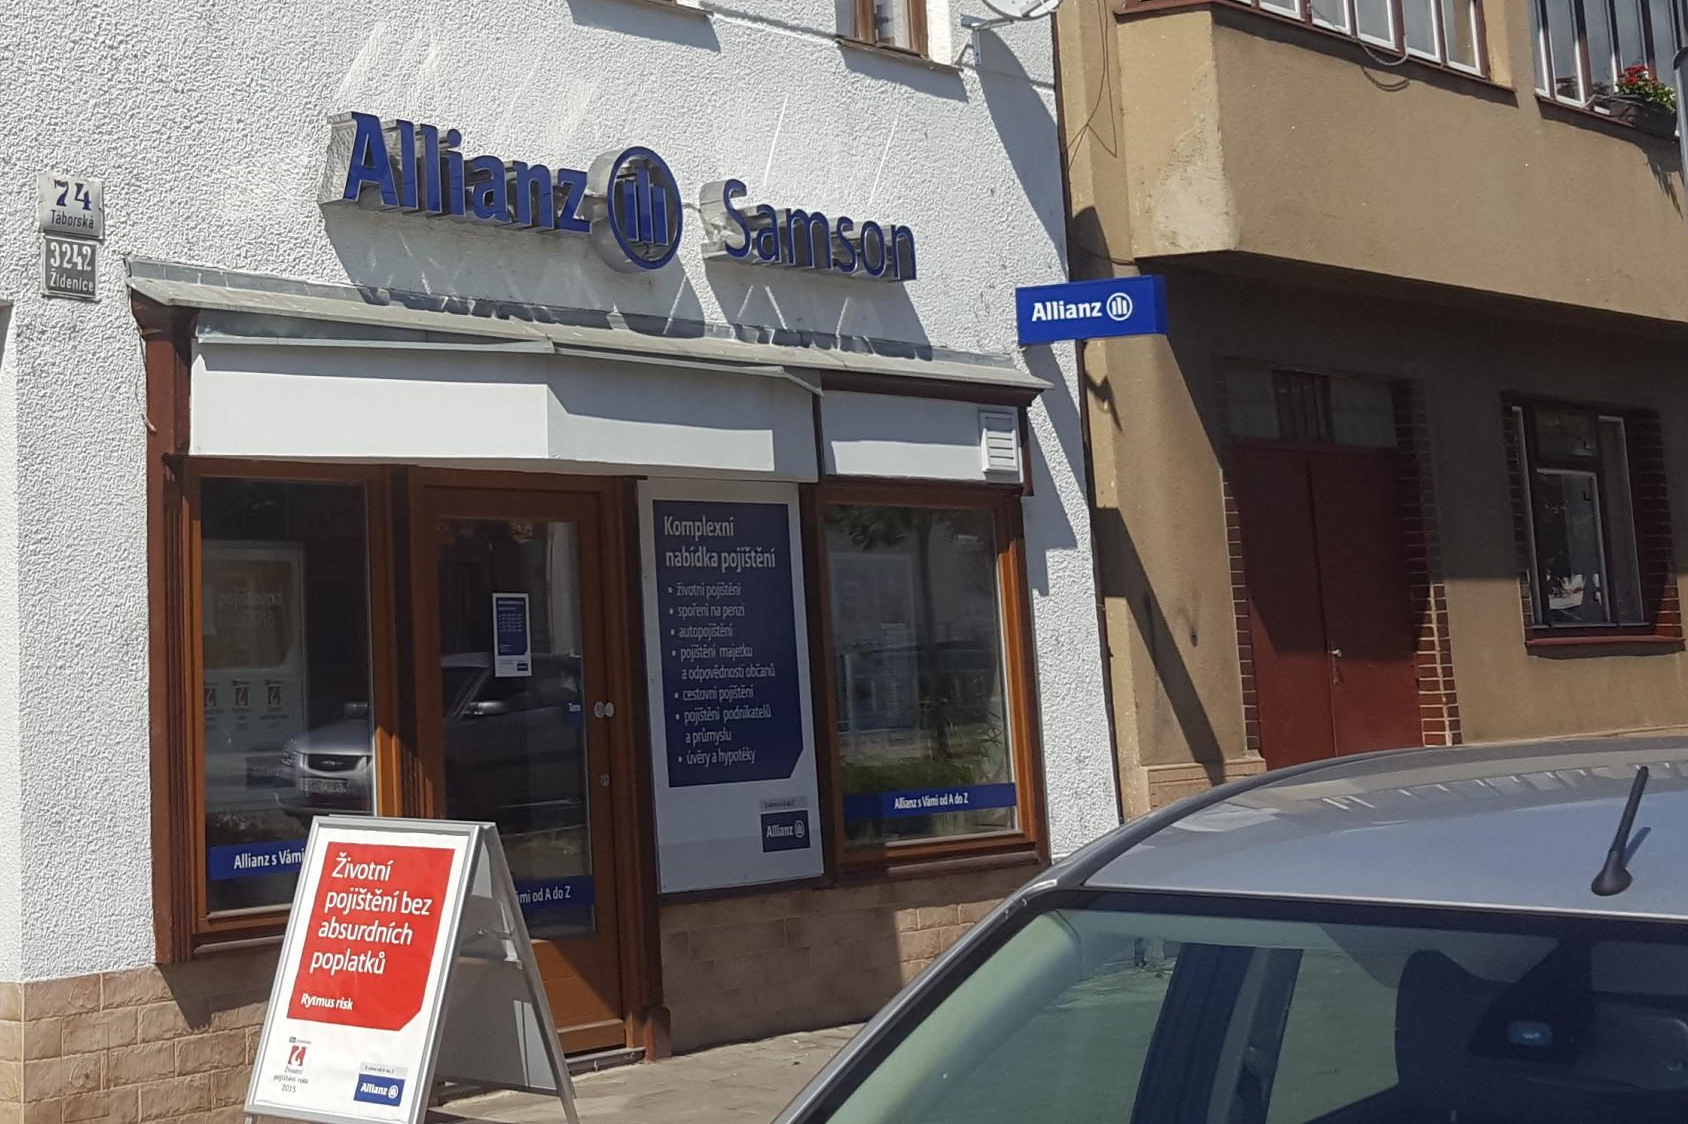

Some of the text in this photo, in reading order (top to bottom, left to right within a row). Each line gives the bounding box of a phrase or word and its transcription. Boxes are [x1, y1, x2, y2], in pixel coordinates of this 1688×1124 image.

[54, 179, 92, 211] 74
[342, 110, 918, 281] Allianz Samson
[50, 209, 94, 229] Táborská
[50, 242, 92, 271] 3242
[50, 268, 94, 292] Židenice
[1031, 301, 1102, 322] Allianz
[664, 516, 734, 541] Komplexní
[665, 546, 776, 573] nabídka pojištění
[676, 582, 741, 600] životní pojištění
[678, 603, 745, 620] spoření na penzi
[679, 623, 733, 641] autopojištění
[680, 644, 752, 662] pojištění majetku
[688, 664, 744, 683] odpovědnosti
[745, 662, 776, 677] občanů
[683, 684, 753, 703] cestovní pojištění
[684, 704, 772, 726] pojištění podnikatelů
[685, 727, 732, 746] a průmyslu
[686, 749, 711, 767] úvěry
[894, 797, 917, 810] Allianz
[922, 795, 938, 808] Vámi
[940, 795, 948, 806] od
[949, 795, 954, 805] A
[954, 793, 963, 805] do
[963, 793, 969, 804] Z
[767, 824, 794, 838] Allianz
[234, 851, 269, 870] Allianz
[271, 854, 277, 866] s
[331, 852, 393, 882] Životní
[324, 887, 432, 916] pojištění bez
[532, 887, 544, 902] od
[545, 888, 551, 901] A
[552, 886, 564, 900] do
[564, 885, 571, 899] Z
[318, 918, 413, 945] absurdních
[309, 950, 385, 976] poplatků
[300, 993, 353, 1011] Rytmus risk
[360, 1082, 388, 1095] Allianz
